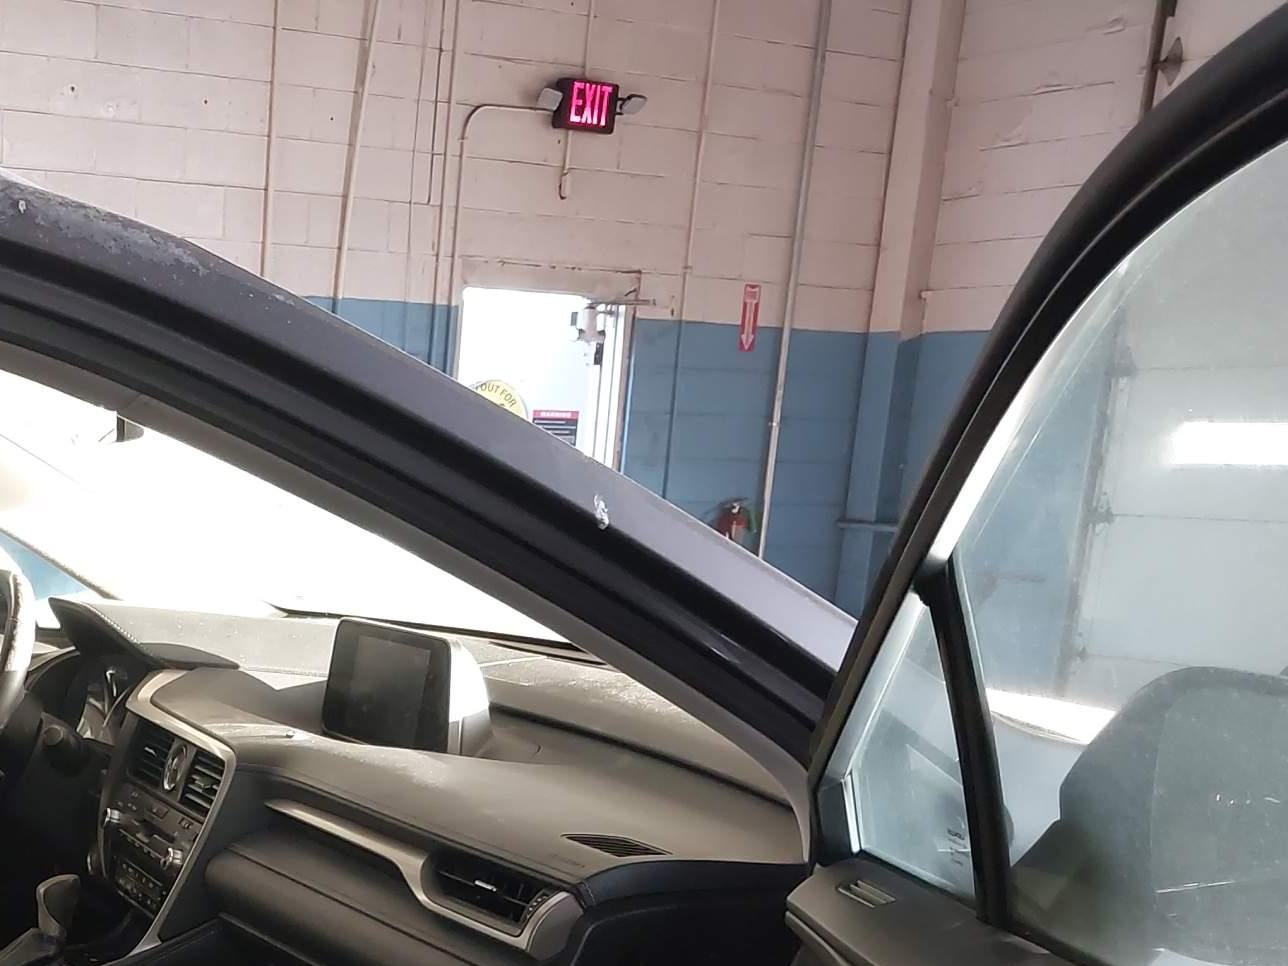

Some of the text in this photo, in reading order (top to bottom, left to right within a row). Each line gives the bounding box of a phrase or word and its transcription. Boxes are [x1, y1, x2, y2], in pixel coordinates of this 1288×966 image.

[569, 81, 613, 126] EXIT
[480, 383, 500, 394] OUT
[499, 388, 517, 408] FOR
